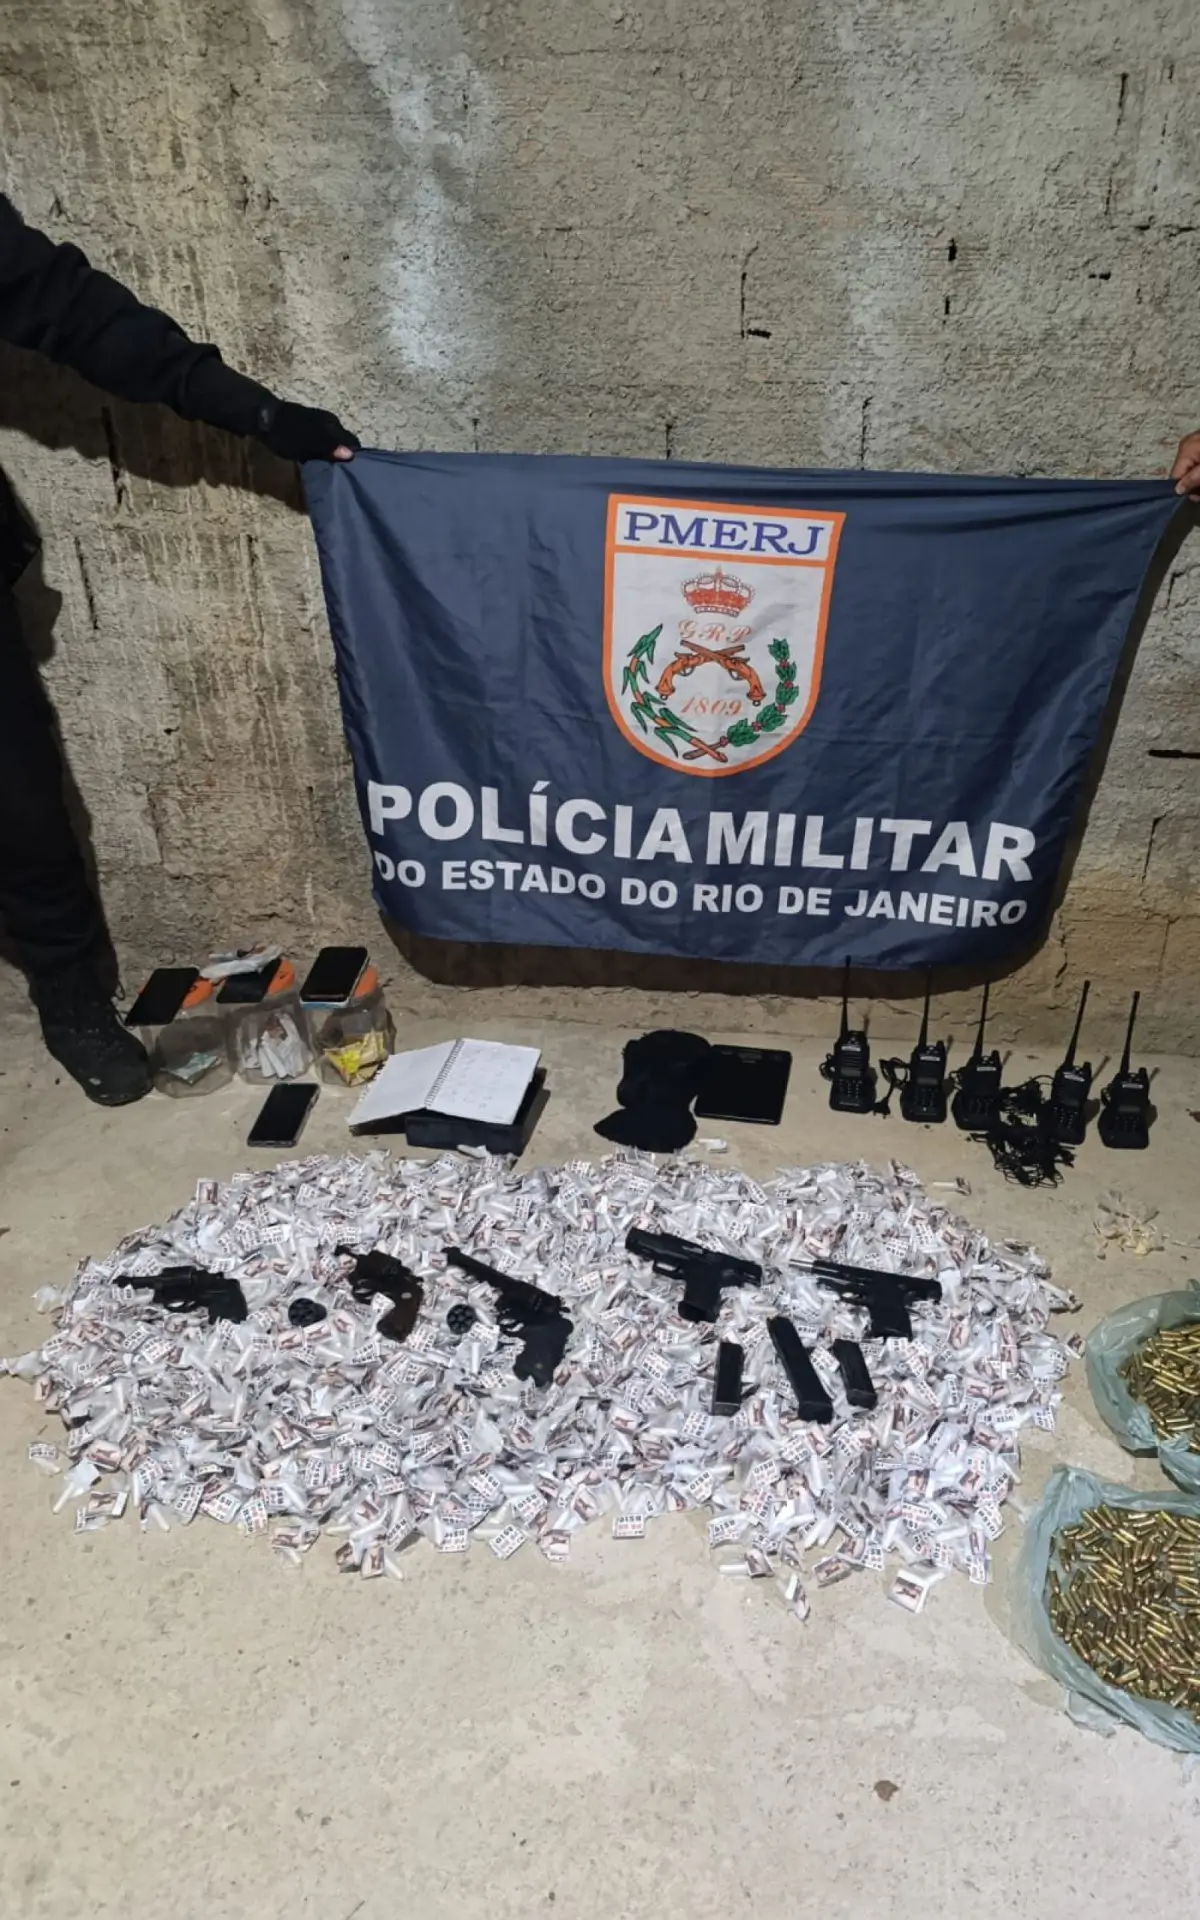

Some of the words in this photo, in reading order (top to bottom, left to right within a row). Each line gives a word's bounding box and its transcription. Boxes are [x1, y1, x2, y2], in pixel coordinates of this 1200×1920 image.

[623, 510, 825, 556] PMERJ
[681, 694, 743, 716] 1809
[367, 779, 693, 864] POLÍCIA
[705, 810, 1036, 882] MILITAR
[373, 850, 427, 888] DO
[441, 859, 606, 900] ESTADO
[620, 877, 678, 909] DO
[692, 882, 764, 913] RIO
[777, 885, 832, 916] DE
[844, 888, 1028, 929] JANEIRO
